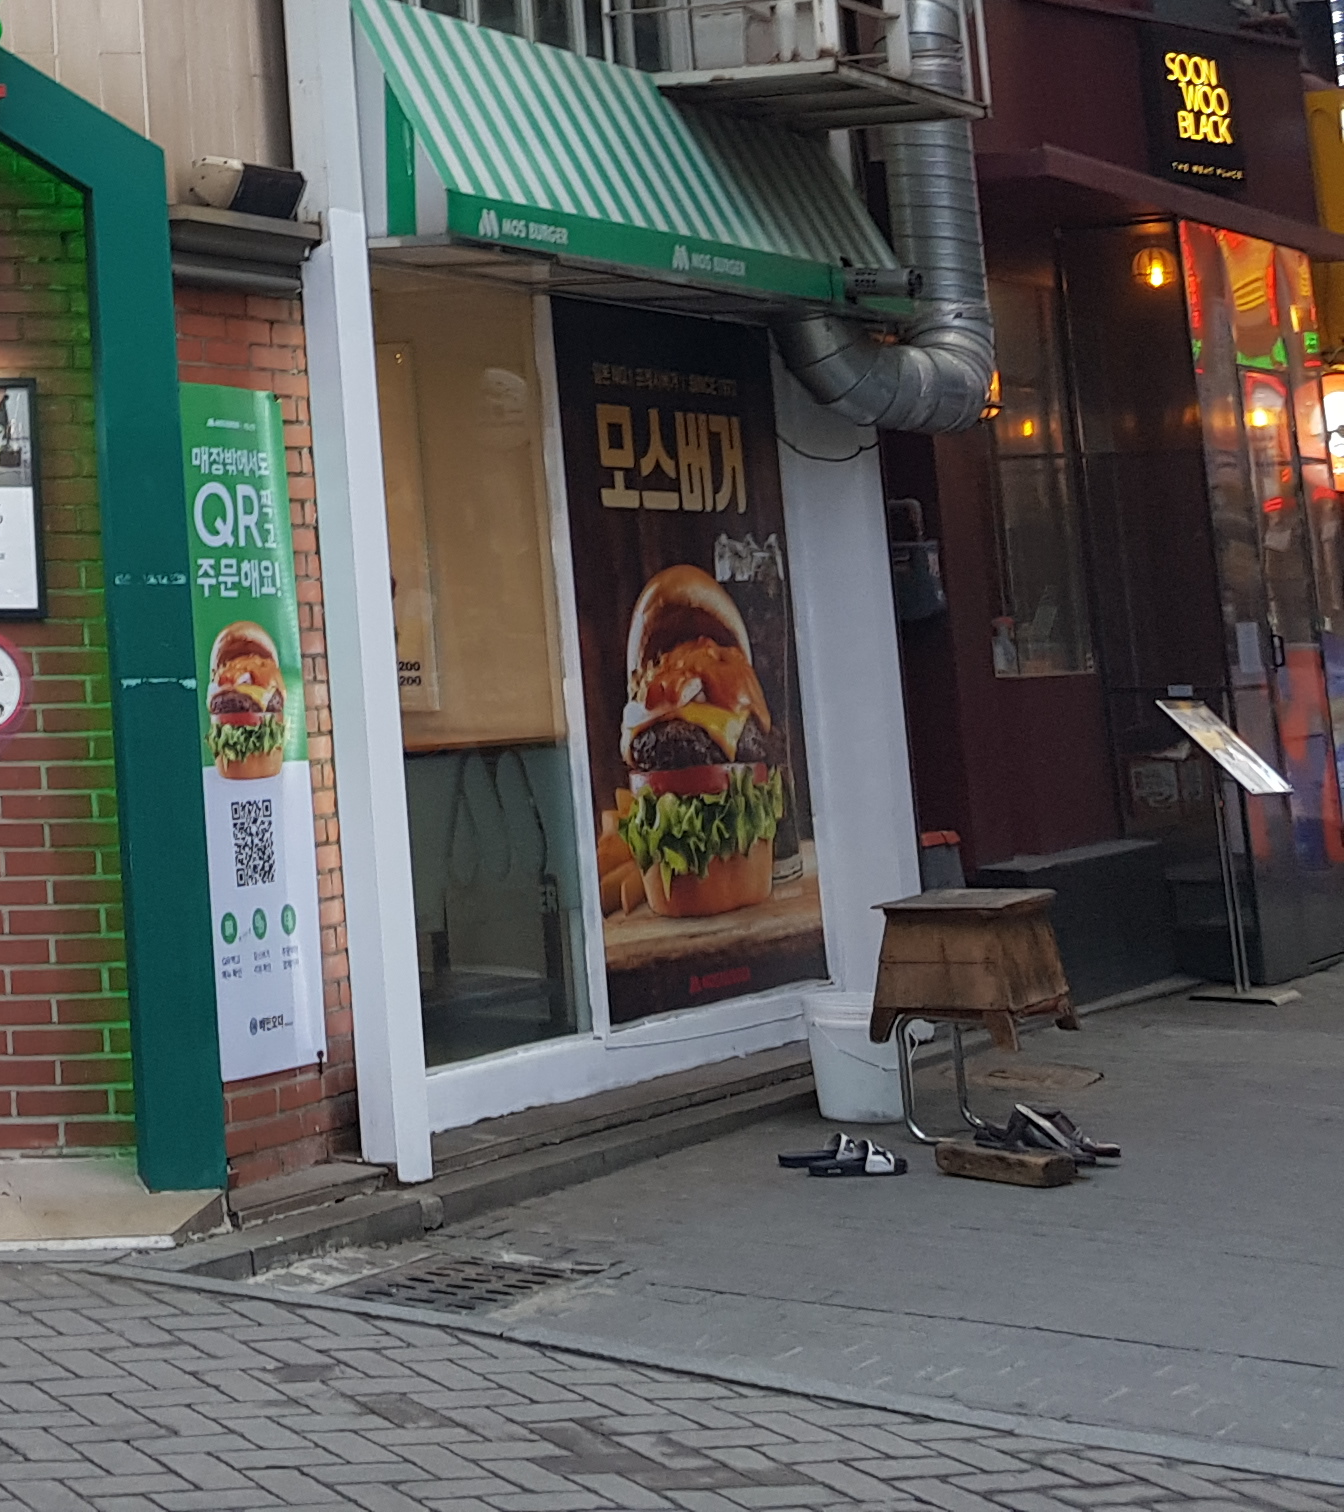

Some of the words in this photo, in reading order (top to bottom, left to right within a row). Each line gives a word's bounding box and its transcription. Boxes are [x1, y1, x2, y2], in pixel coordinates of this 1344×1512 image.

[1164, 51, 1218, 87] SOON
[1178, 82, 1230, 116] WOO
[1177, 110, 1233, 145] BLACK
[596, 403, 747, 514] 모스버거
[193, 481, 263, 548] QR
[196, 558, 283, 598] 주문해요!
